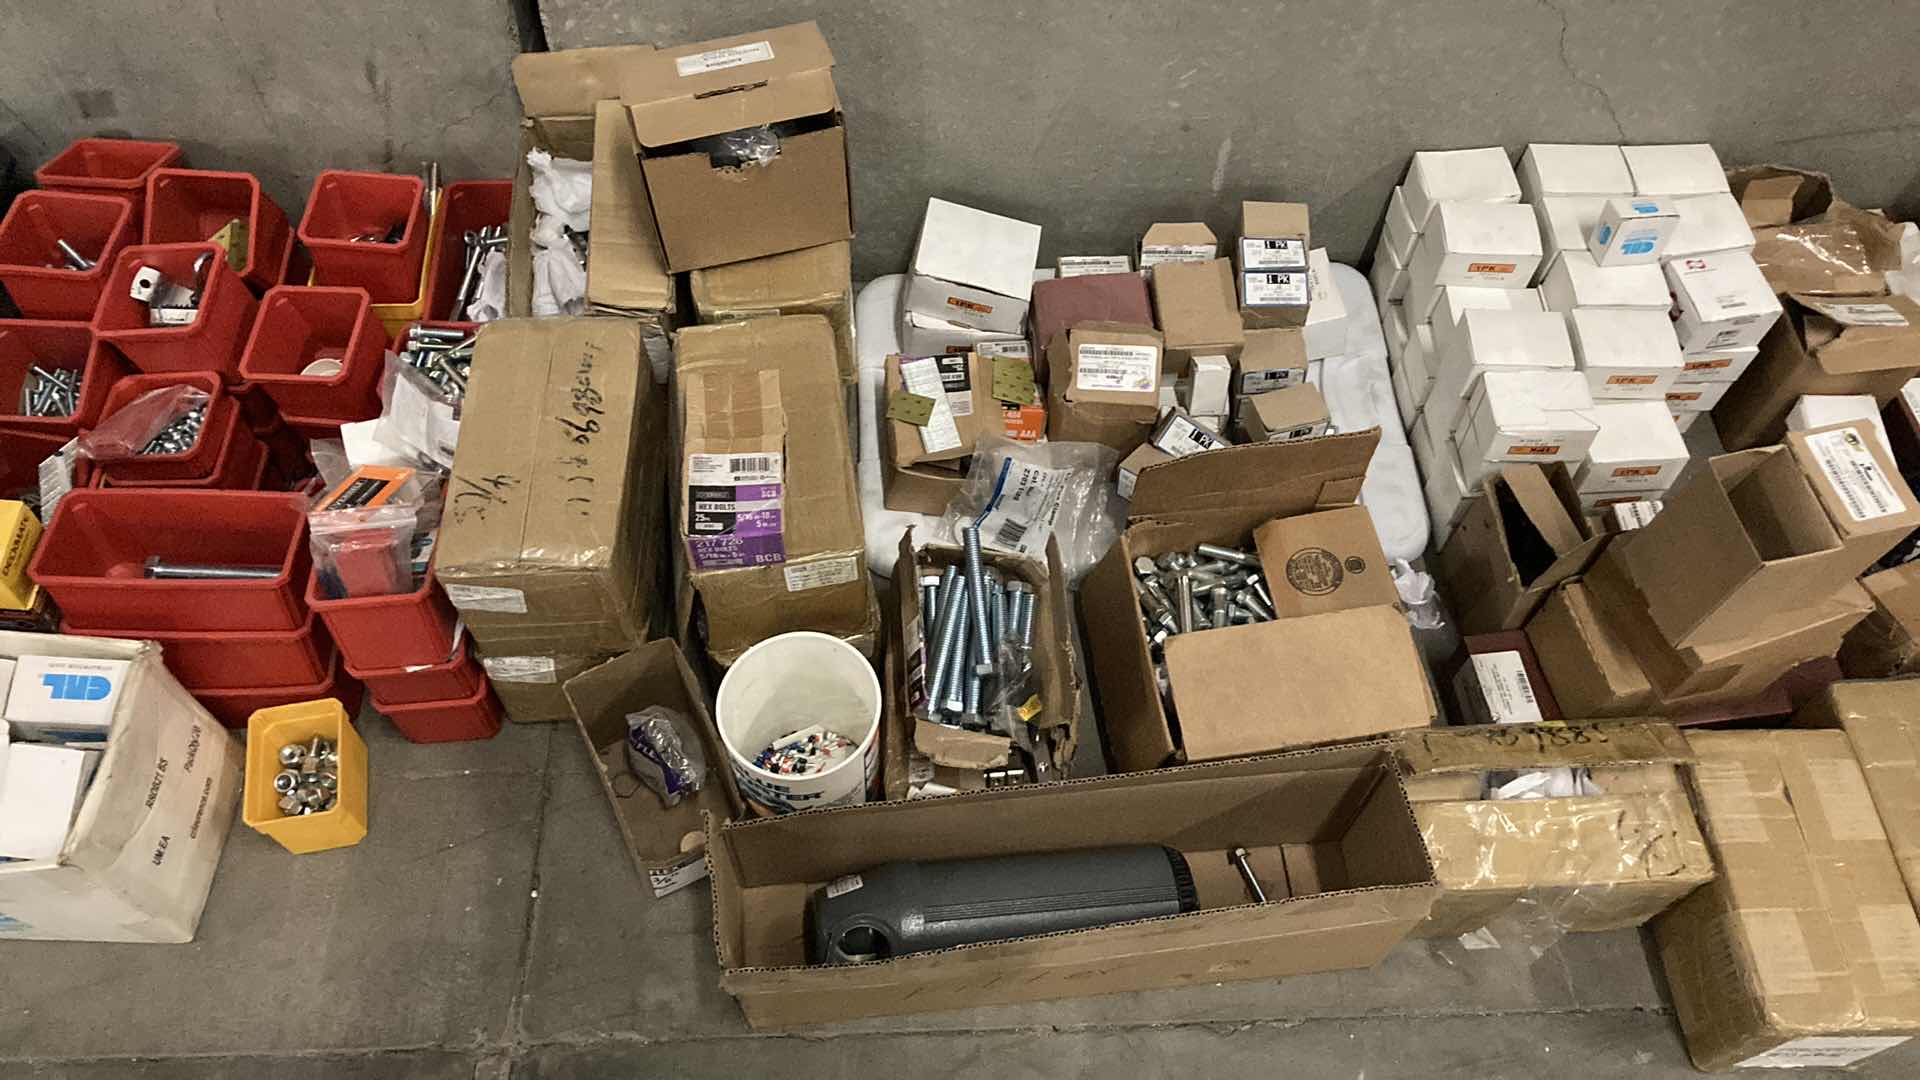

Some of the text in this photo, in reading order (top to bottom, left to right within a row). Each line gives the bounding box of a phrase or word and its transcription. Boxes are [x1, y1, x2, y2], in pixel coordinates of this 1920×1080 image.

[1275, 240, 1287, 249] PK
[1278, 274, 1290, 284] PK
[1200, 436, 1213, 449] PK
[699, 503, 736, 511] HEX BOLTS
[755, 552, 782, 563] BCB
